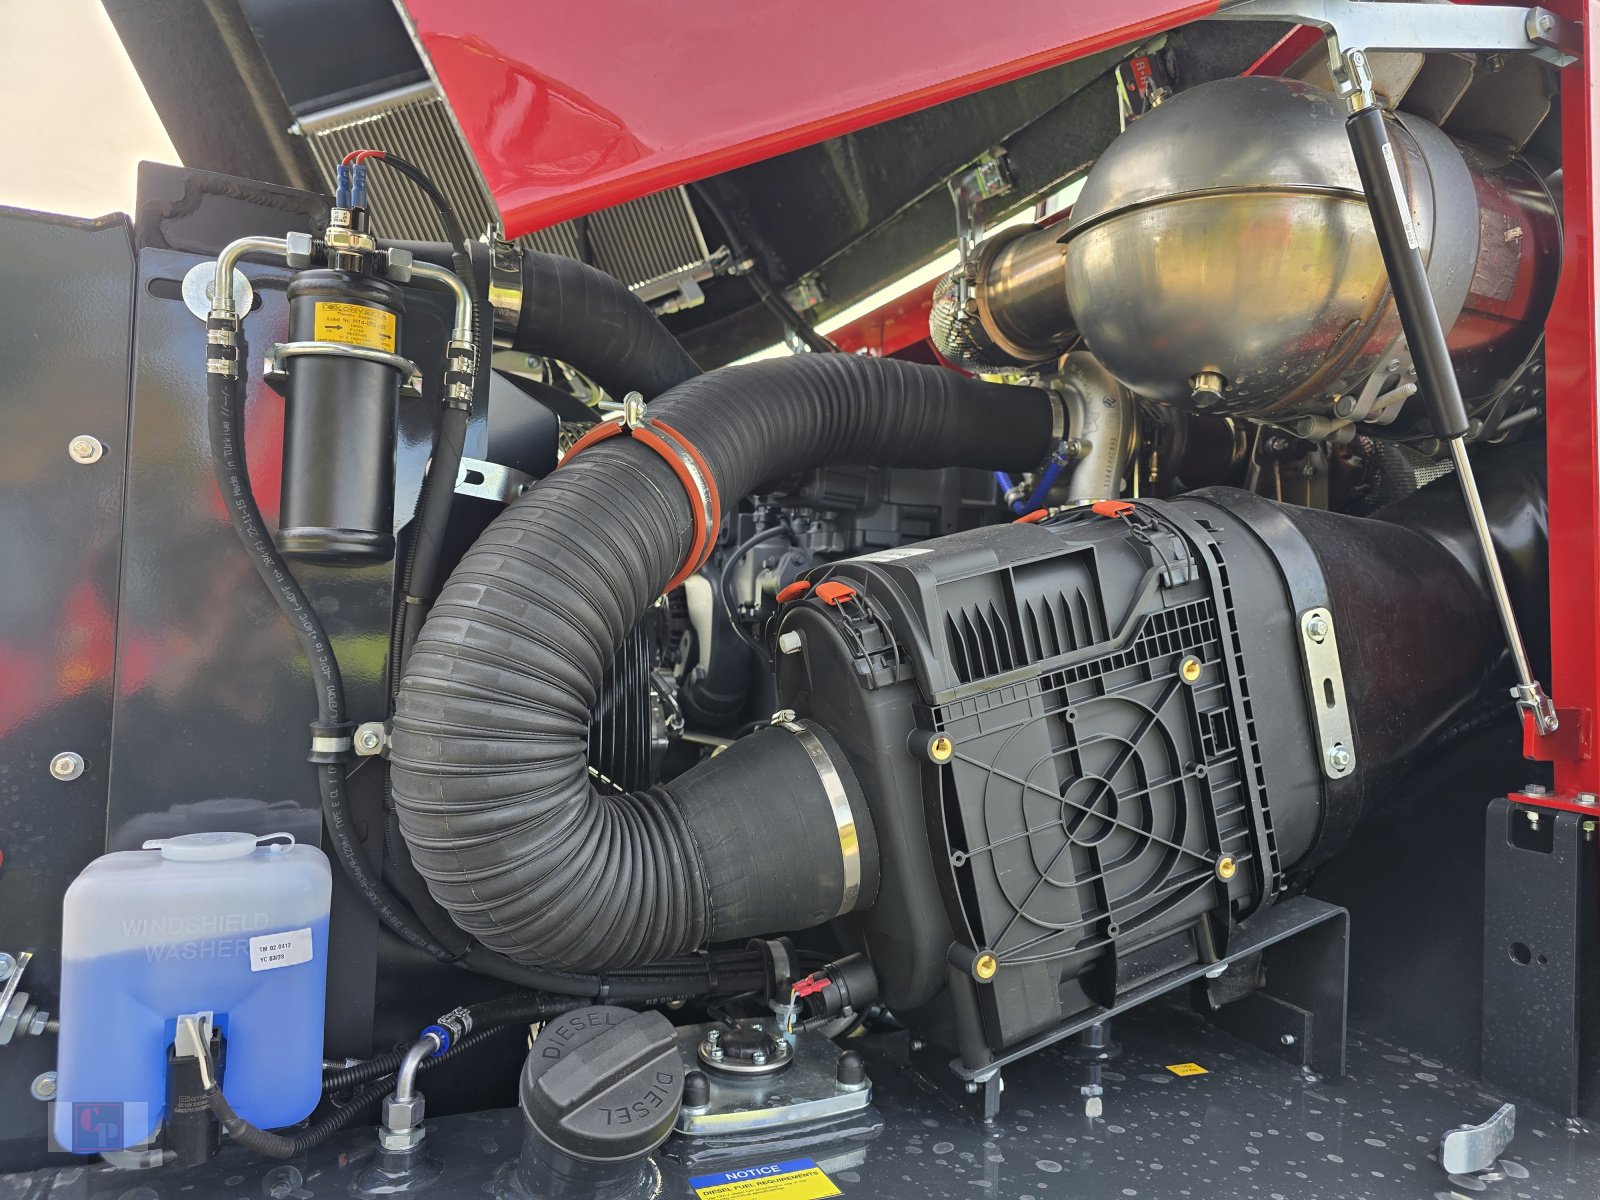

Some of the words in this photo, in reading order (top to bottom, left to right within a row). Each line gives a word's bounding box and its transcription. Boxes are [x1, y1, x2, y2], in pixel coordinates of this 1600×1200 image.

[226, 461, 236, 471] in
[230, 475, 242, 497] Made
[332, 810, 344, 829] TYPE
[122, 912, 269, 939] WINDSHIELD
[145, 938, 250, 963] WASHER
[542, 1012, 617, 1060] DIESEL
[599, 1072, 674, 1126] DIESEL
[703, 1187, 731, 1196] DIESEL
[733, 1183, 754, 1191] FUEL
[756, 1171, 819, 1186] REQUIREMENTS
[725, 1164, 782, 1181] NOTICE
